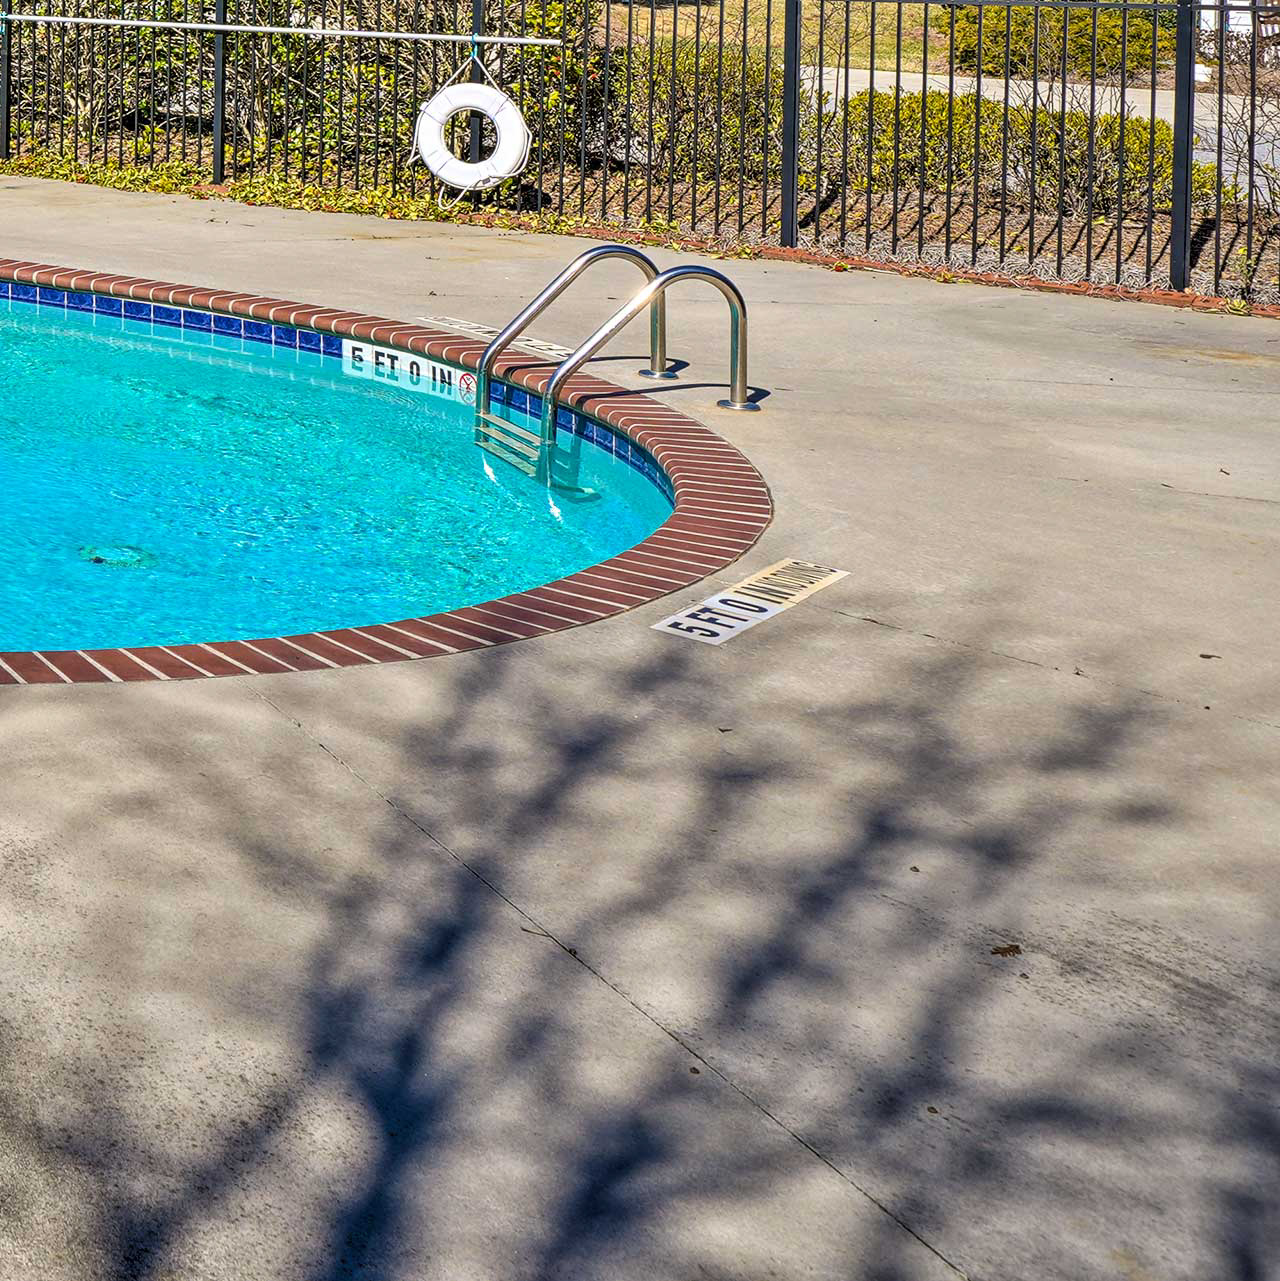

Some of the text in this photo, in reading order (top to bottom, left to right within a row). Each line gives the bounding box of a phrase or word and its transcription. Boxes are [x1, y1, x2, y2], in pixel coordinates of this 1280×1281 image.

[351, 346, 364, 371] 5
[374, 350, 399, 380] FT
[431, 366, 452, 394] IN
[733, 583, 796, 605] IN
[685, 607, 750, 629] FT
[667, 621, 720, 638] 5
